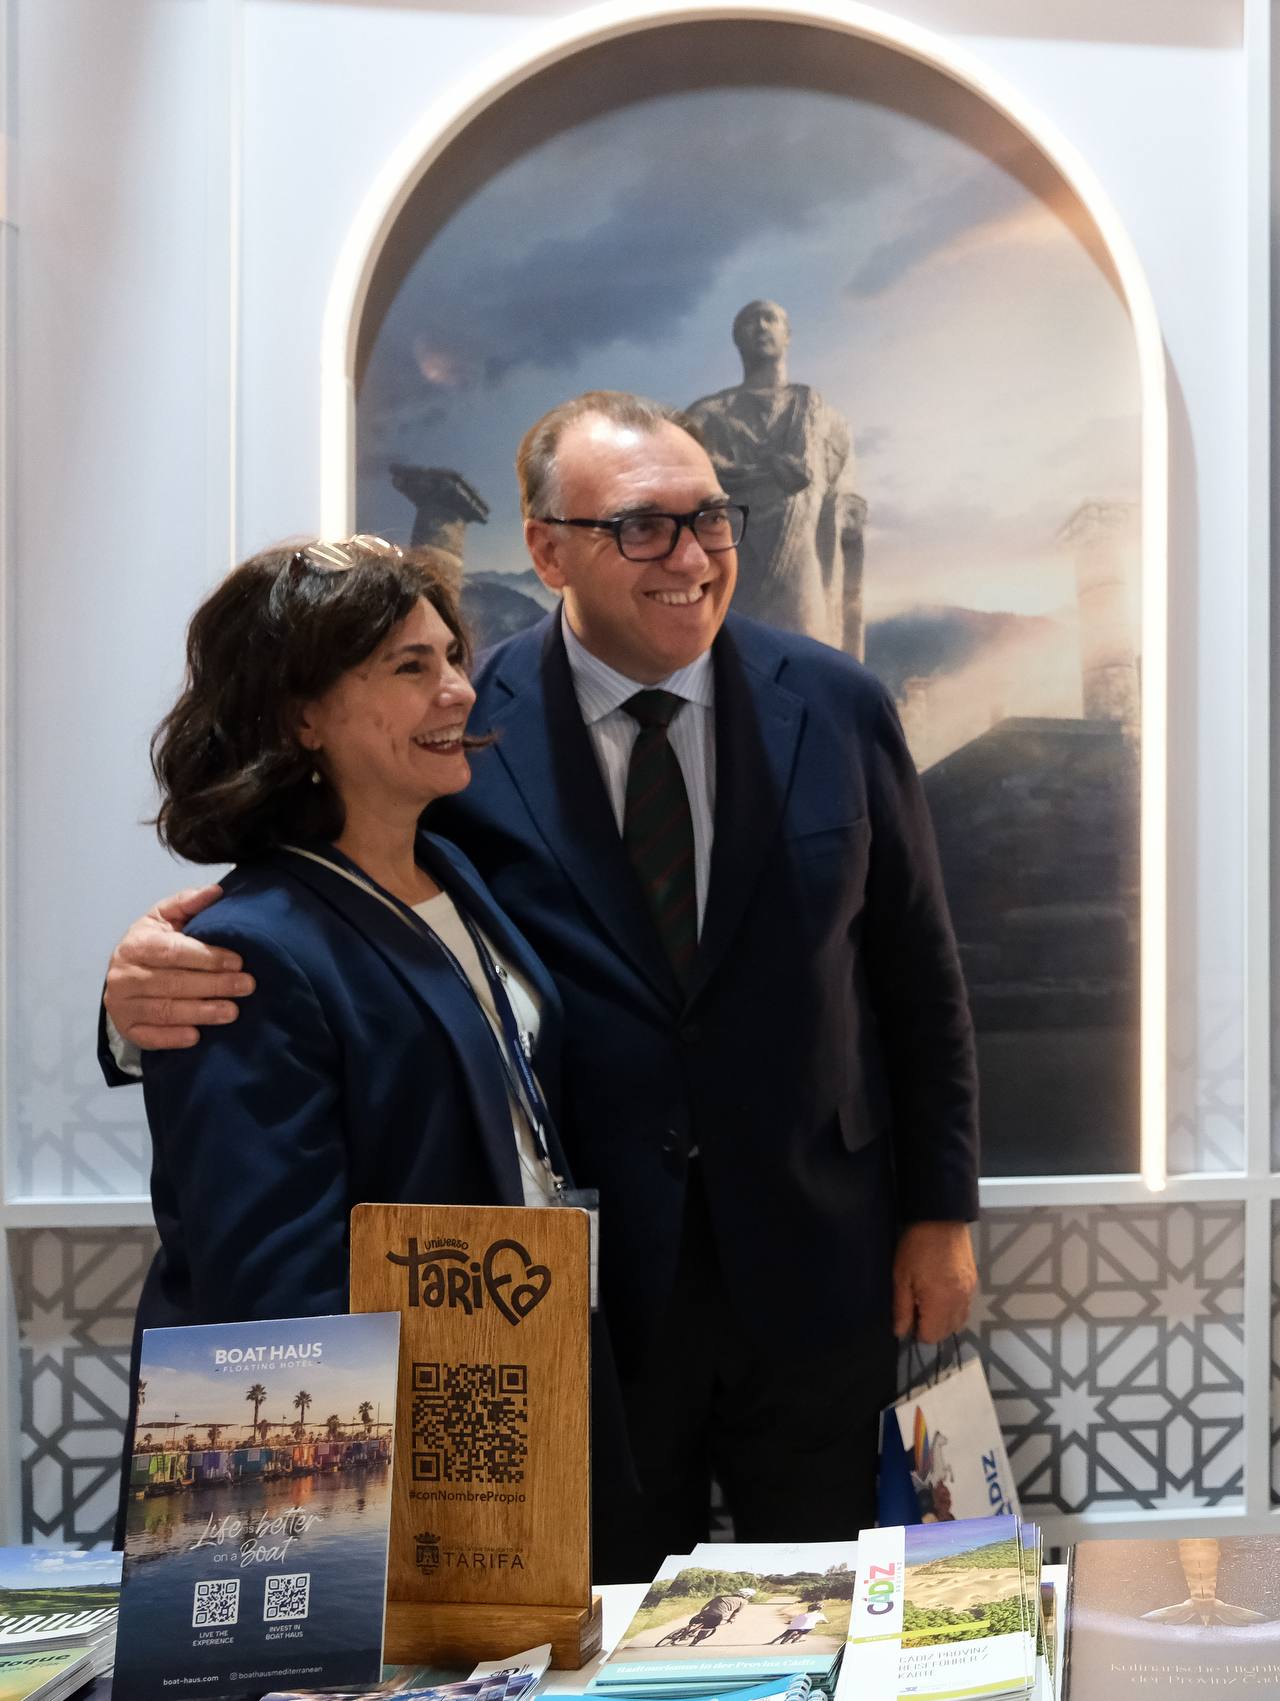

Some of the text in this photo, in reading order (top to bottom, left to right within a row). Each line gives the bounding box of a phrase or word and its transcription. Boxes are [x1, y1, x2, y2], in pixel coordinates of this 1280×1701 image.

[215, 1342, 323, 1365] BOAT HAUS
[223, 1359, 314, 1373] FLOATING HOTEL
[408, 1490, 527, 1505] #conNombrePropio
[189, 1511, 242, 1550] Life
[255, 1506, 323, 1538] better
[213, 1535, 299, 1568] on a Boat
[443, 1551, 525, 1570] TARIFA
[199, 1631, 214, 1639] LIVE
[265, 1632, 284, 1640] BOAT
[269, 1625, 293, 1633] INVEST
[192, 1637, 235, 1647] EXPERIENCE
[163, 1665, 323, 1686] boat-haus.com boathausmediterranean
